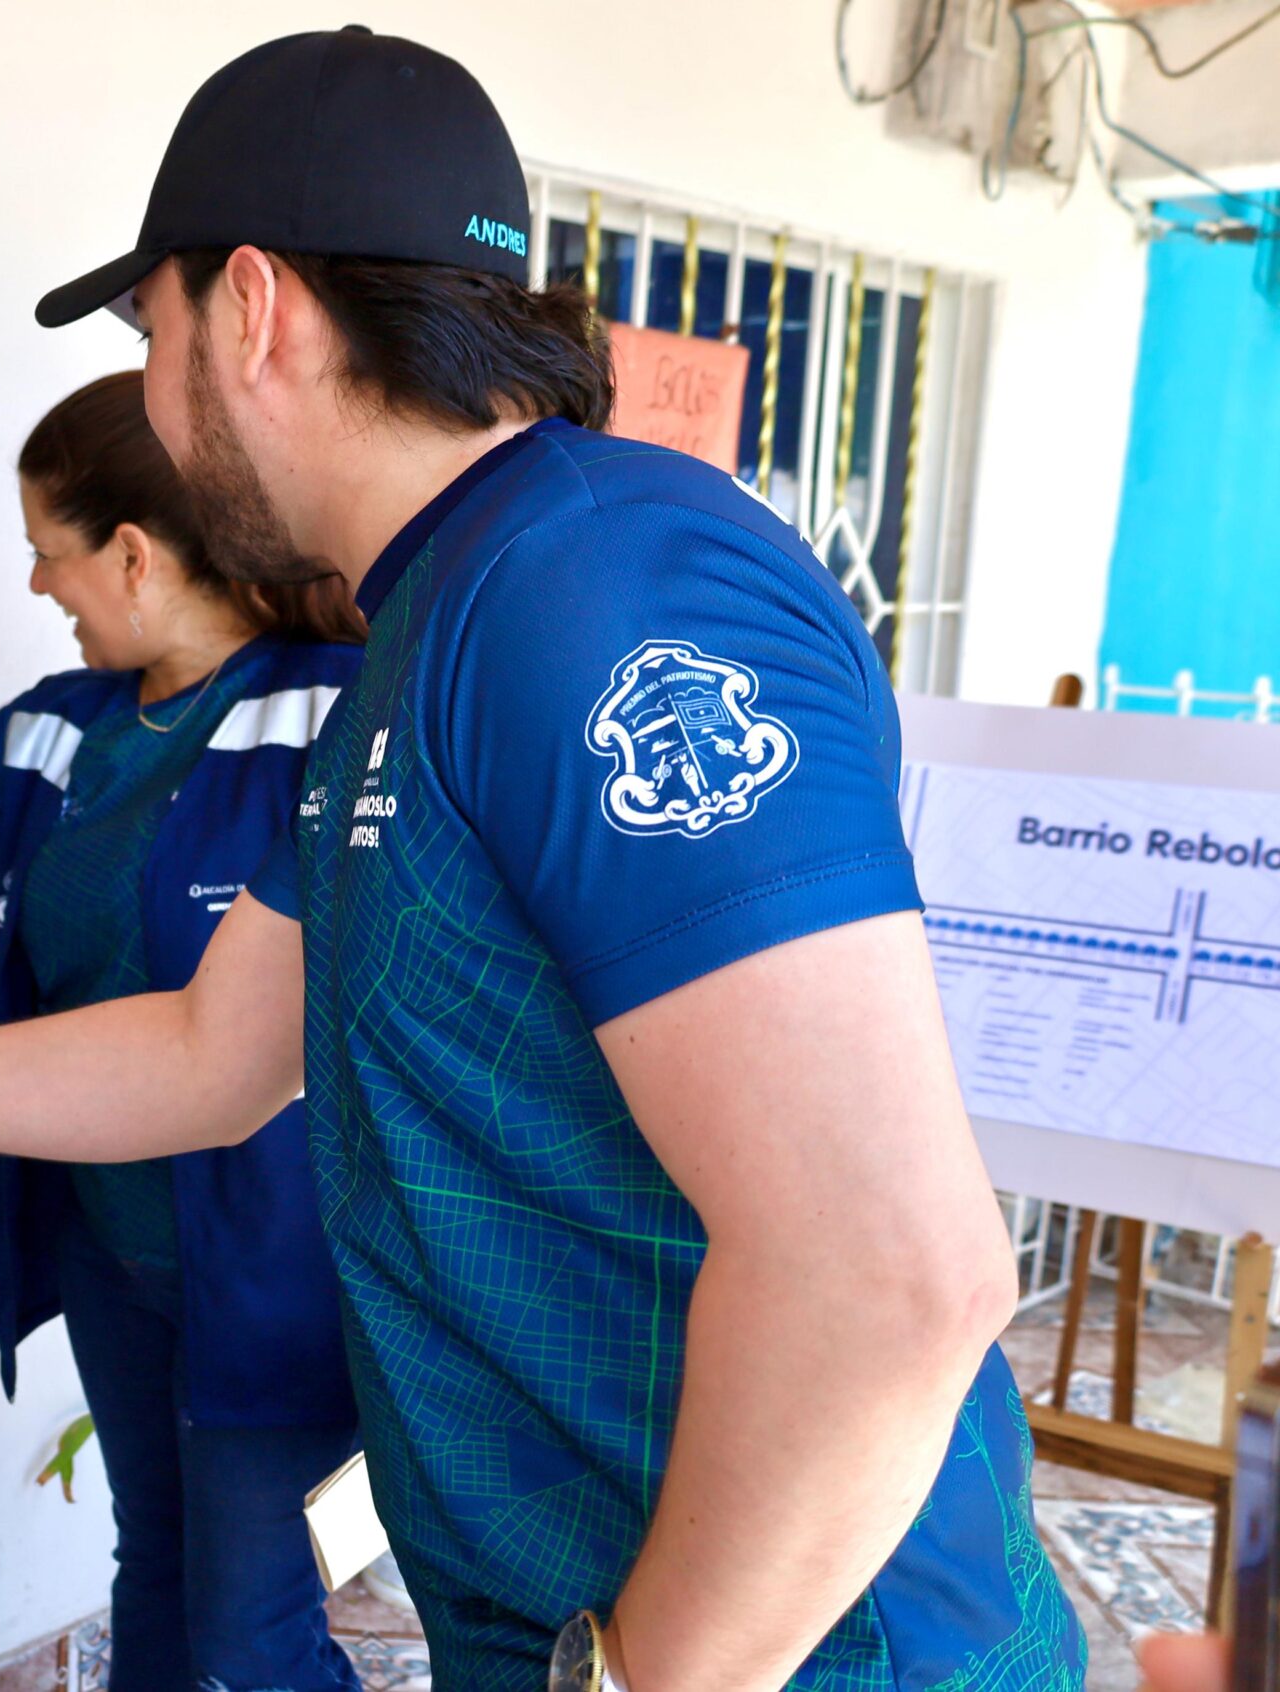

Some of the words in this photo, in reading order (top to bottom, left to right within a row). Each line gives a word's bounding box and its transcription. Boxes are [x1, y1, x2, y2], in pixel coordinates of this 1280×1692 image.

[464, 214, 527, 257] ANDRES
[619, 689, 647, 716] PREMIO
[644, 680, 662, 694] DEL
[660, 670, 717, 685] PATRIOTISMO
[1017, 815, 1133, 854] Barrio
